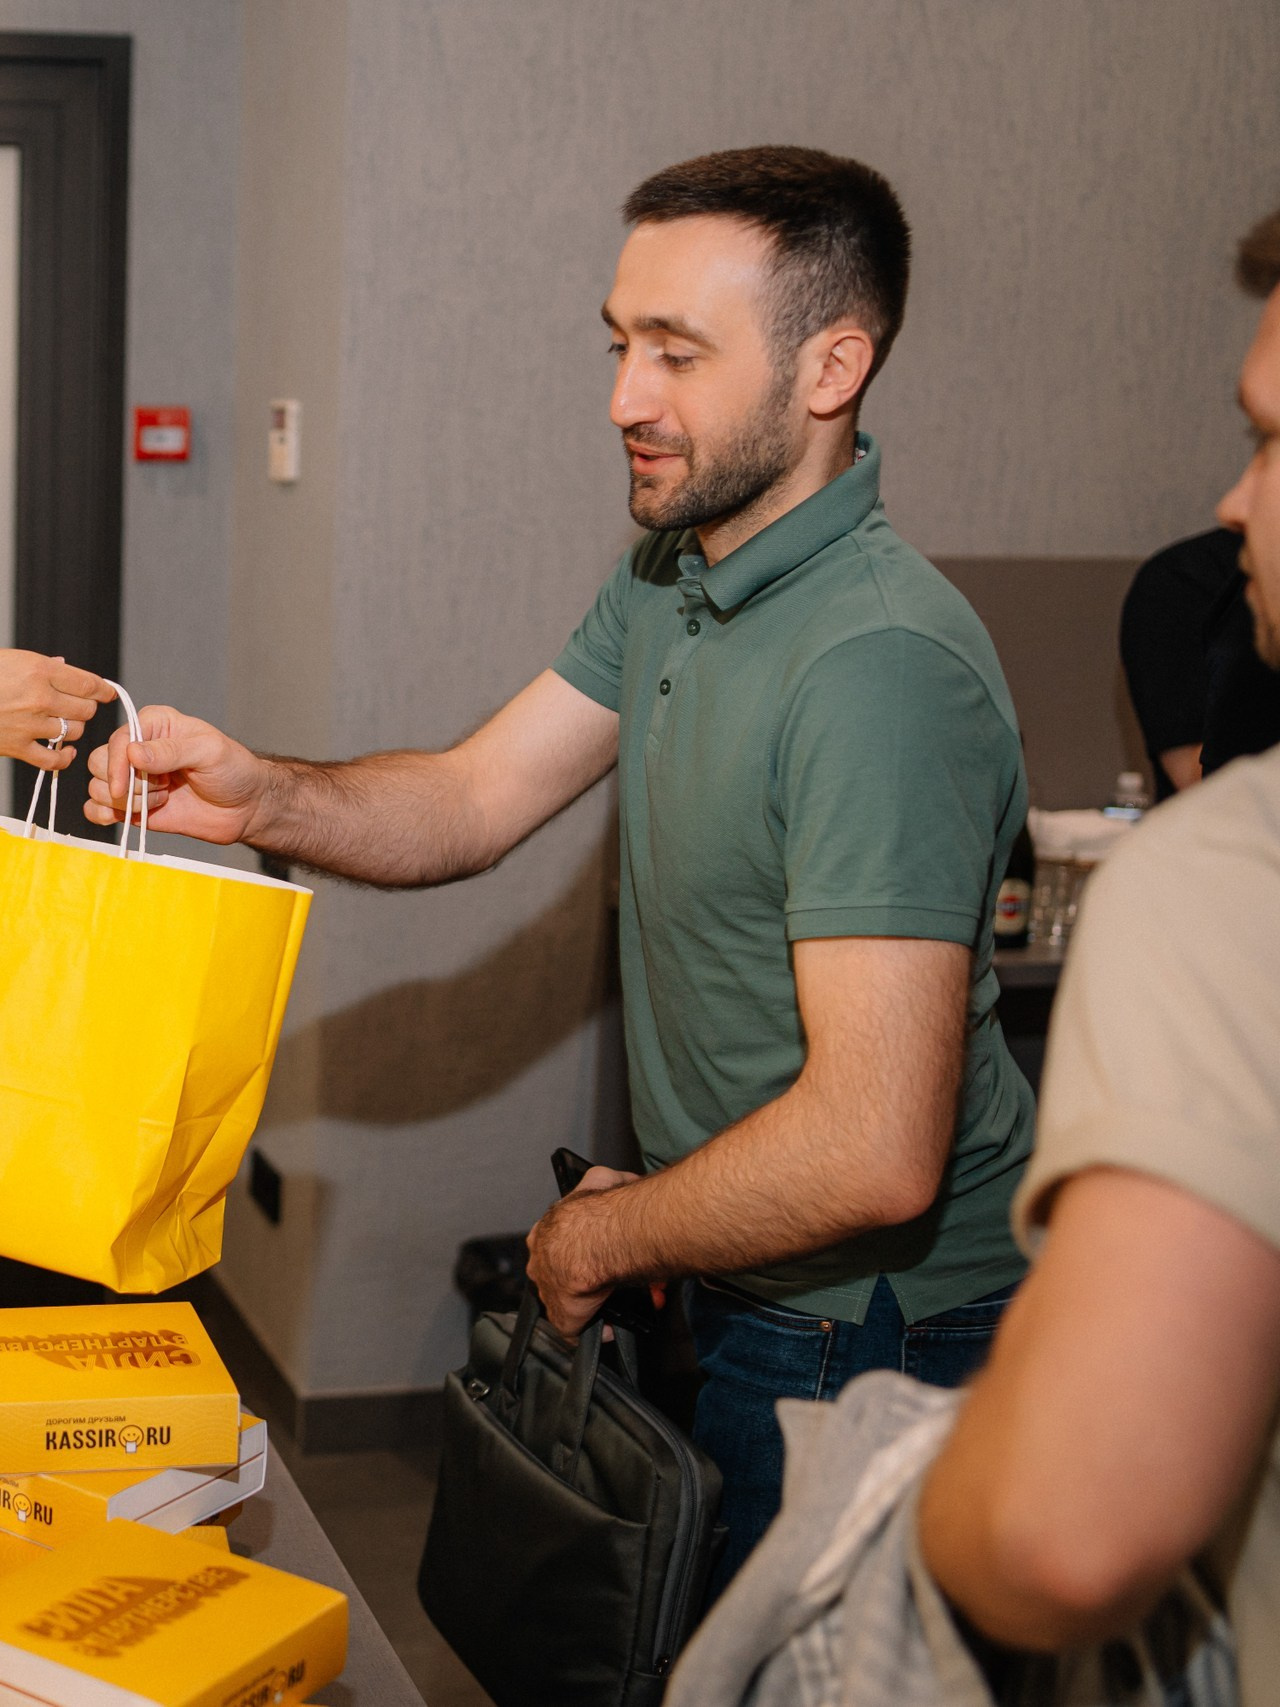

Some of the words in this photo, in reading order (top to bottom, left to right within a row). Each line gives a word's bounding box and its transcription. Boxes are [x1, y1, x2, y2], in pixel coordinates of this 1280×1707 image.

[65, 1348, 201, 1370] СИЛА
[46, 1417, 86, 1426] ДОРОГИМ
[88, 1415, 126, 1424] ДРУЗЬЯМ
[46, 1428, 117, 1450] KASSIR
